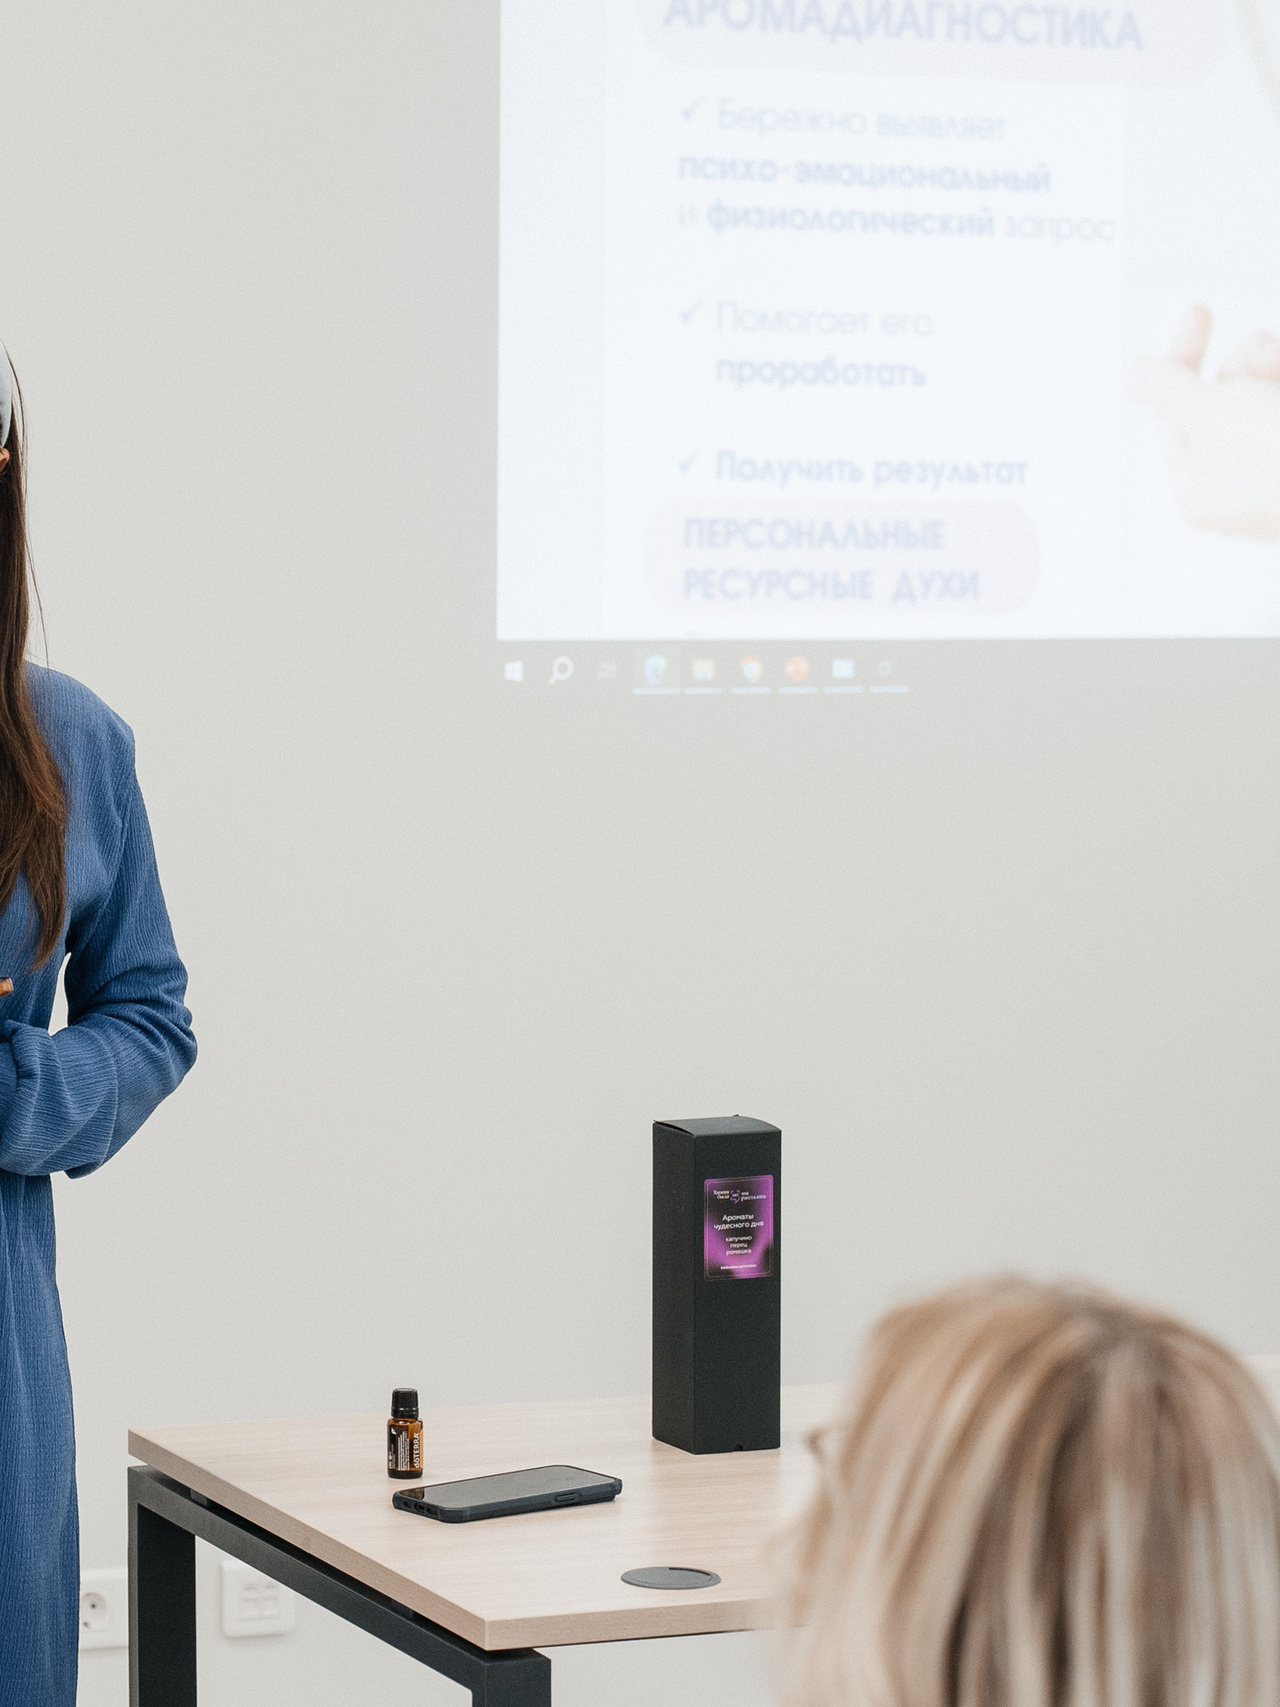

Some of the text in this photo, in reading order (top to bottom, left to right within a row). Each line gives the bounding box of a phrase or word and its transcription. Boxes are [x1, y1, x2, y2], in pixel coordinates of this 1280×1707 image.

[663, 0, 1144, 50] АРОМАДИАГНОСТИКА
[718, 96, 1006, 140] Бережно выявляет
[677, 153, 1051, 194] психо-эмоциональный
[677, 198, 1114, 245] и физиологический запрос
[715, 299, 934, 338] Помогает его
[714, 354, 927, 390] проработать
[714, 449, 1029, 491] Получить результат
[682, 517, 946, 550] ПЕРСОНАЛЬНЫЕ
[682, 567, 981, 606] РЕСУРСНЫЕ ДУХИ
[713, 1222, 750, 1231] чудесного
[722, 1214, 754, 1222] Ароматы
